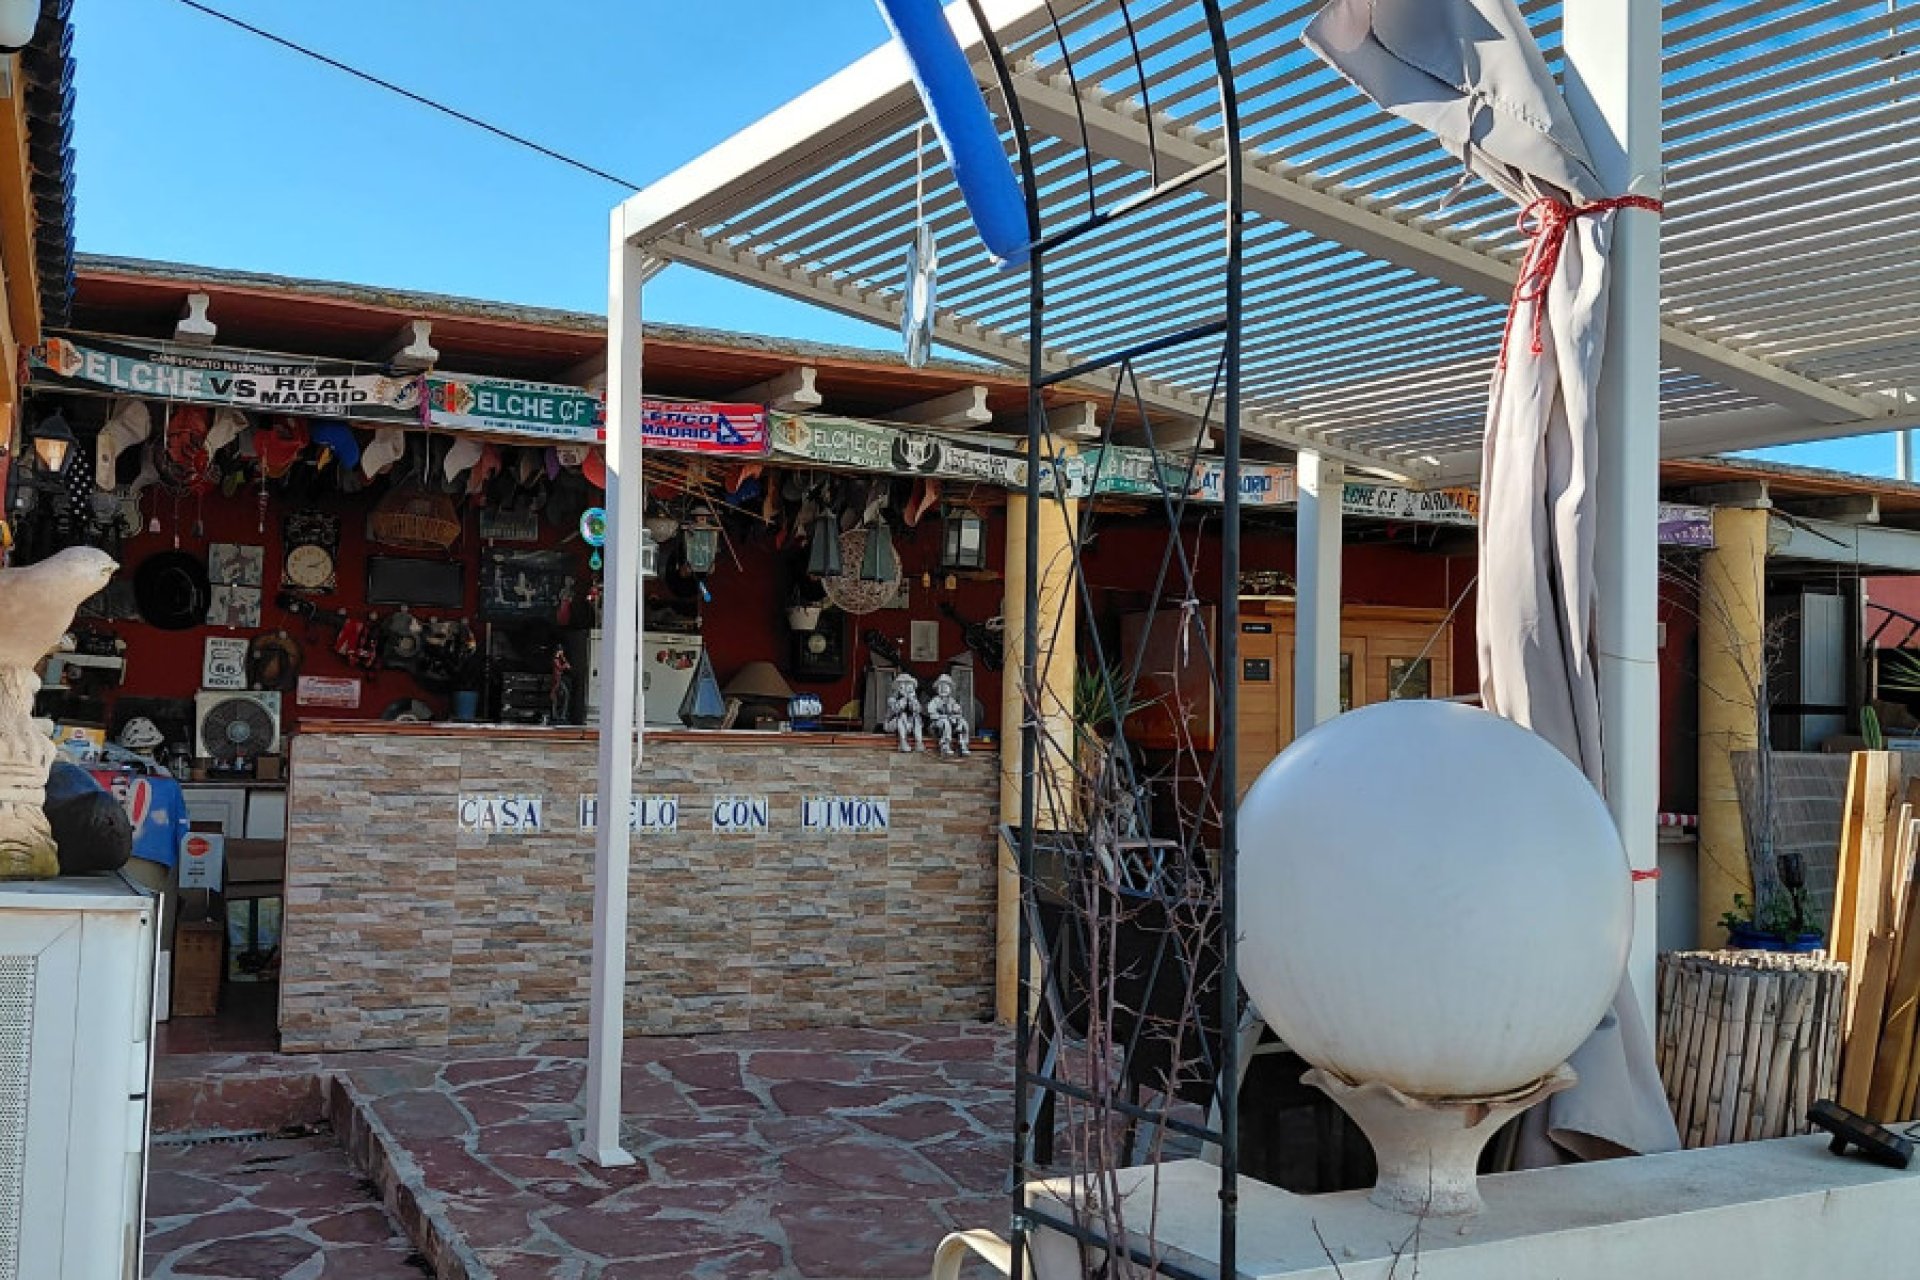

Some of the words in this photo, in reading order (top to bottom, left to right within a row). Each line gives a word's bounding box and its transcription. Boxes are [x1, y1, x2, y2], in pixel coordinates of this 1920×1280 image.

[86, 351, 204, 396] ELCHE
[210, 376, 257, 398] VS
[275, 378, 355, 392] REAL
[260, 389, 367, 404] MADRID
[477, 390, 554, 419] ELCHE
[559, 399, 588, 422] CF
[814, 428, 865, 453] ELCHE
[460, 799, 539, 827] CASA
[714, 801, 767, 827] CON
